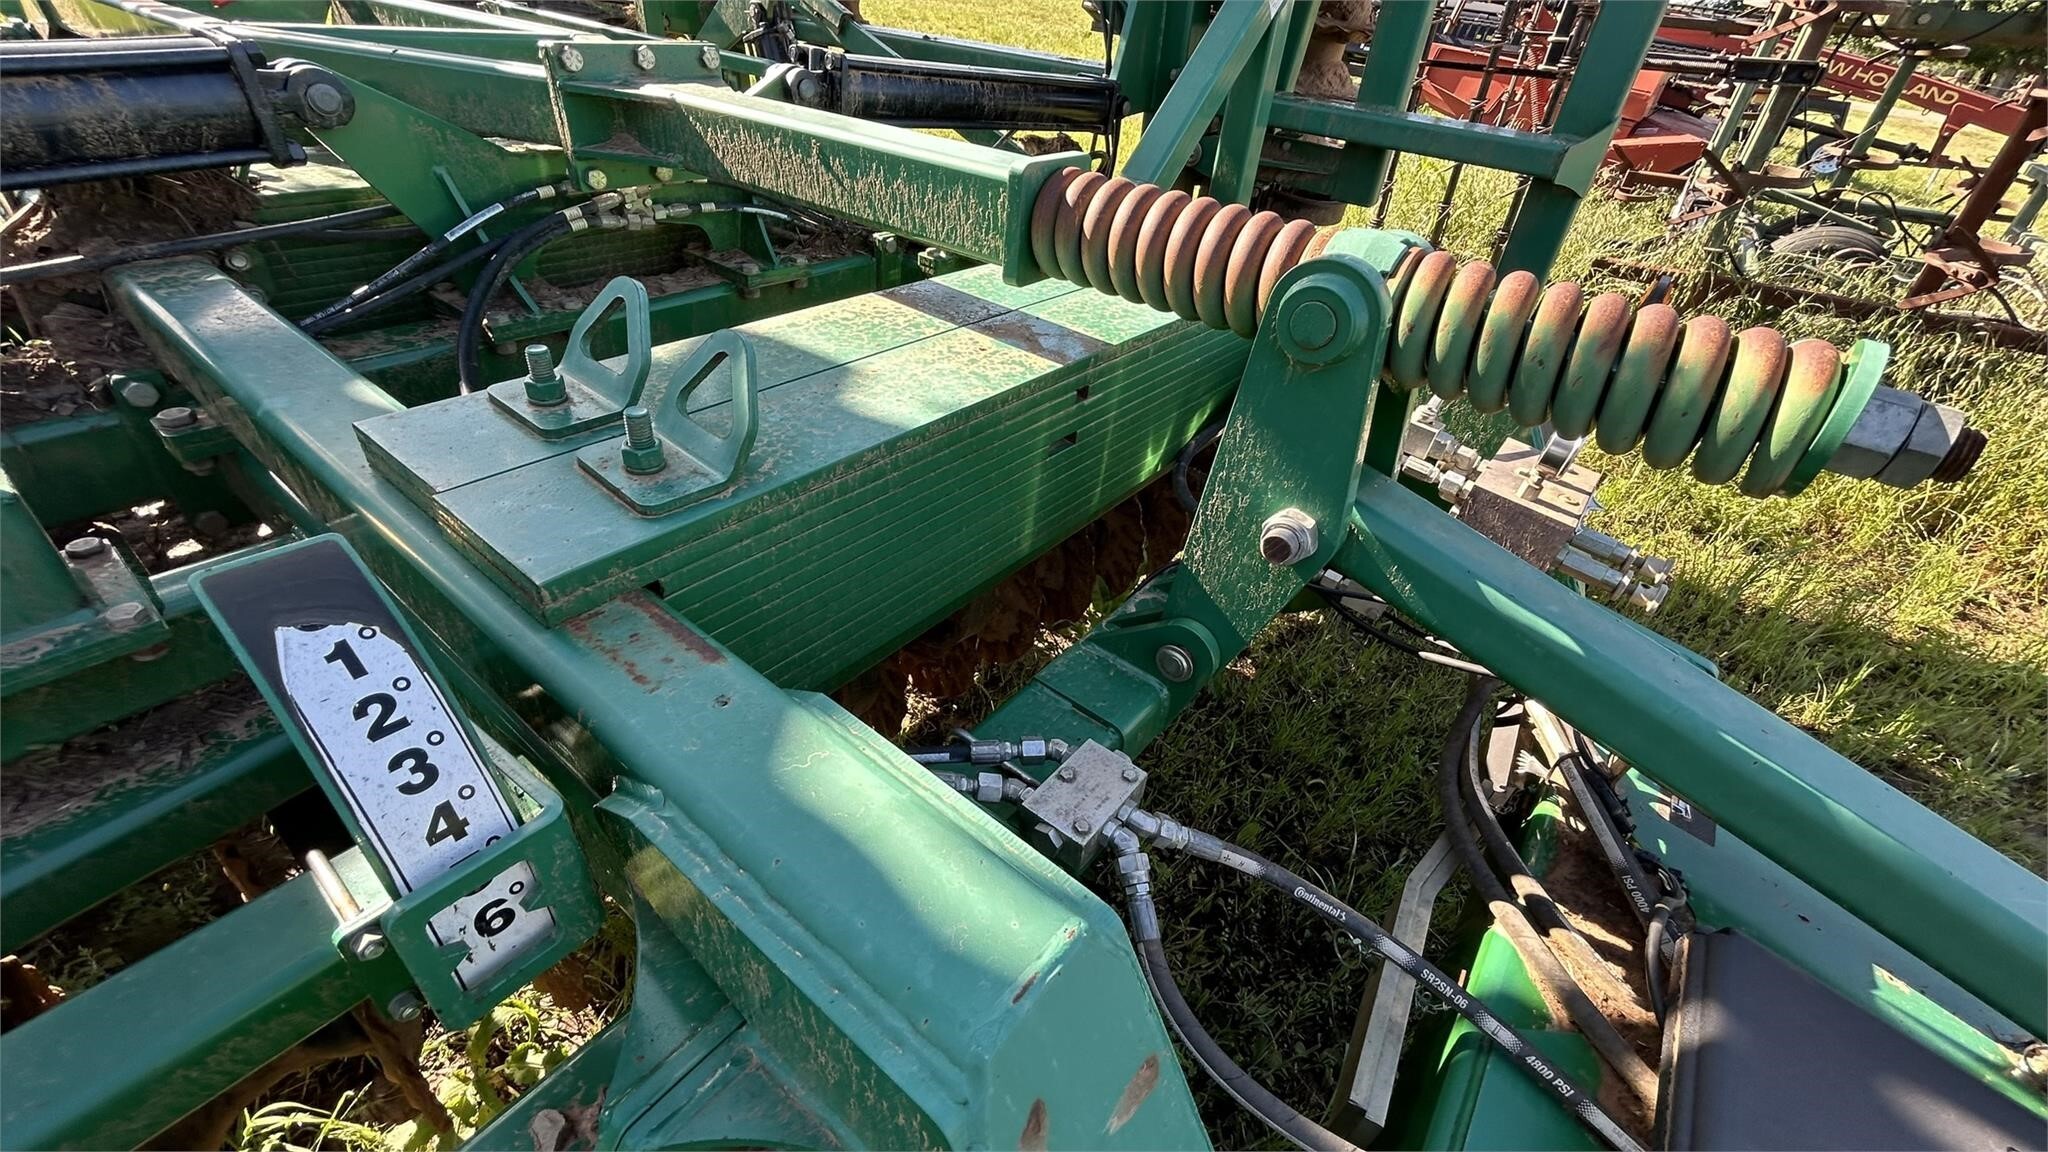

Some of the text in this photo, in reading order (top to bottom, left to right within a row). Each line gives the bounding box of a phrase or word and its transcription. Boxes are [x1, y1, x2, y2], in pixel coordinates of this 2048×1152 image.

[1293, 886, 1341, 918] Continental
[1622, 875, 1650, 913] 4000 PSI
[1420, 969, 1469, 1009] SR2SN-06
[1525, 1055, 1575, 1098] 4800 PSI
